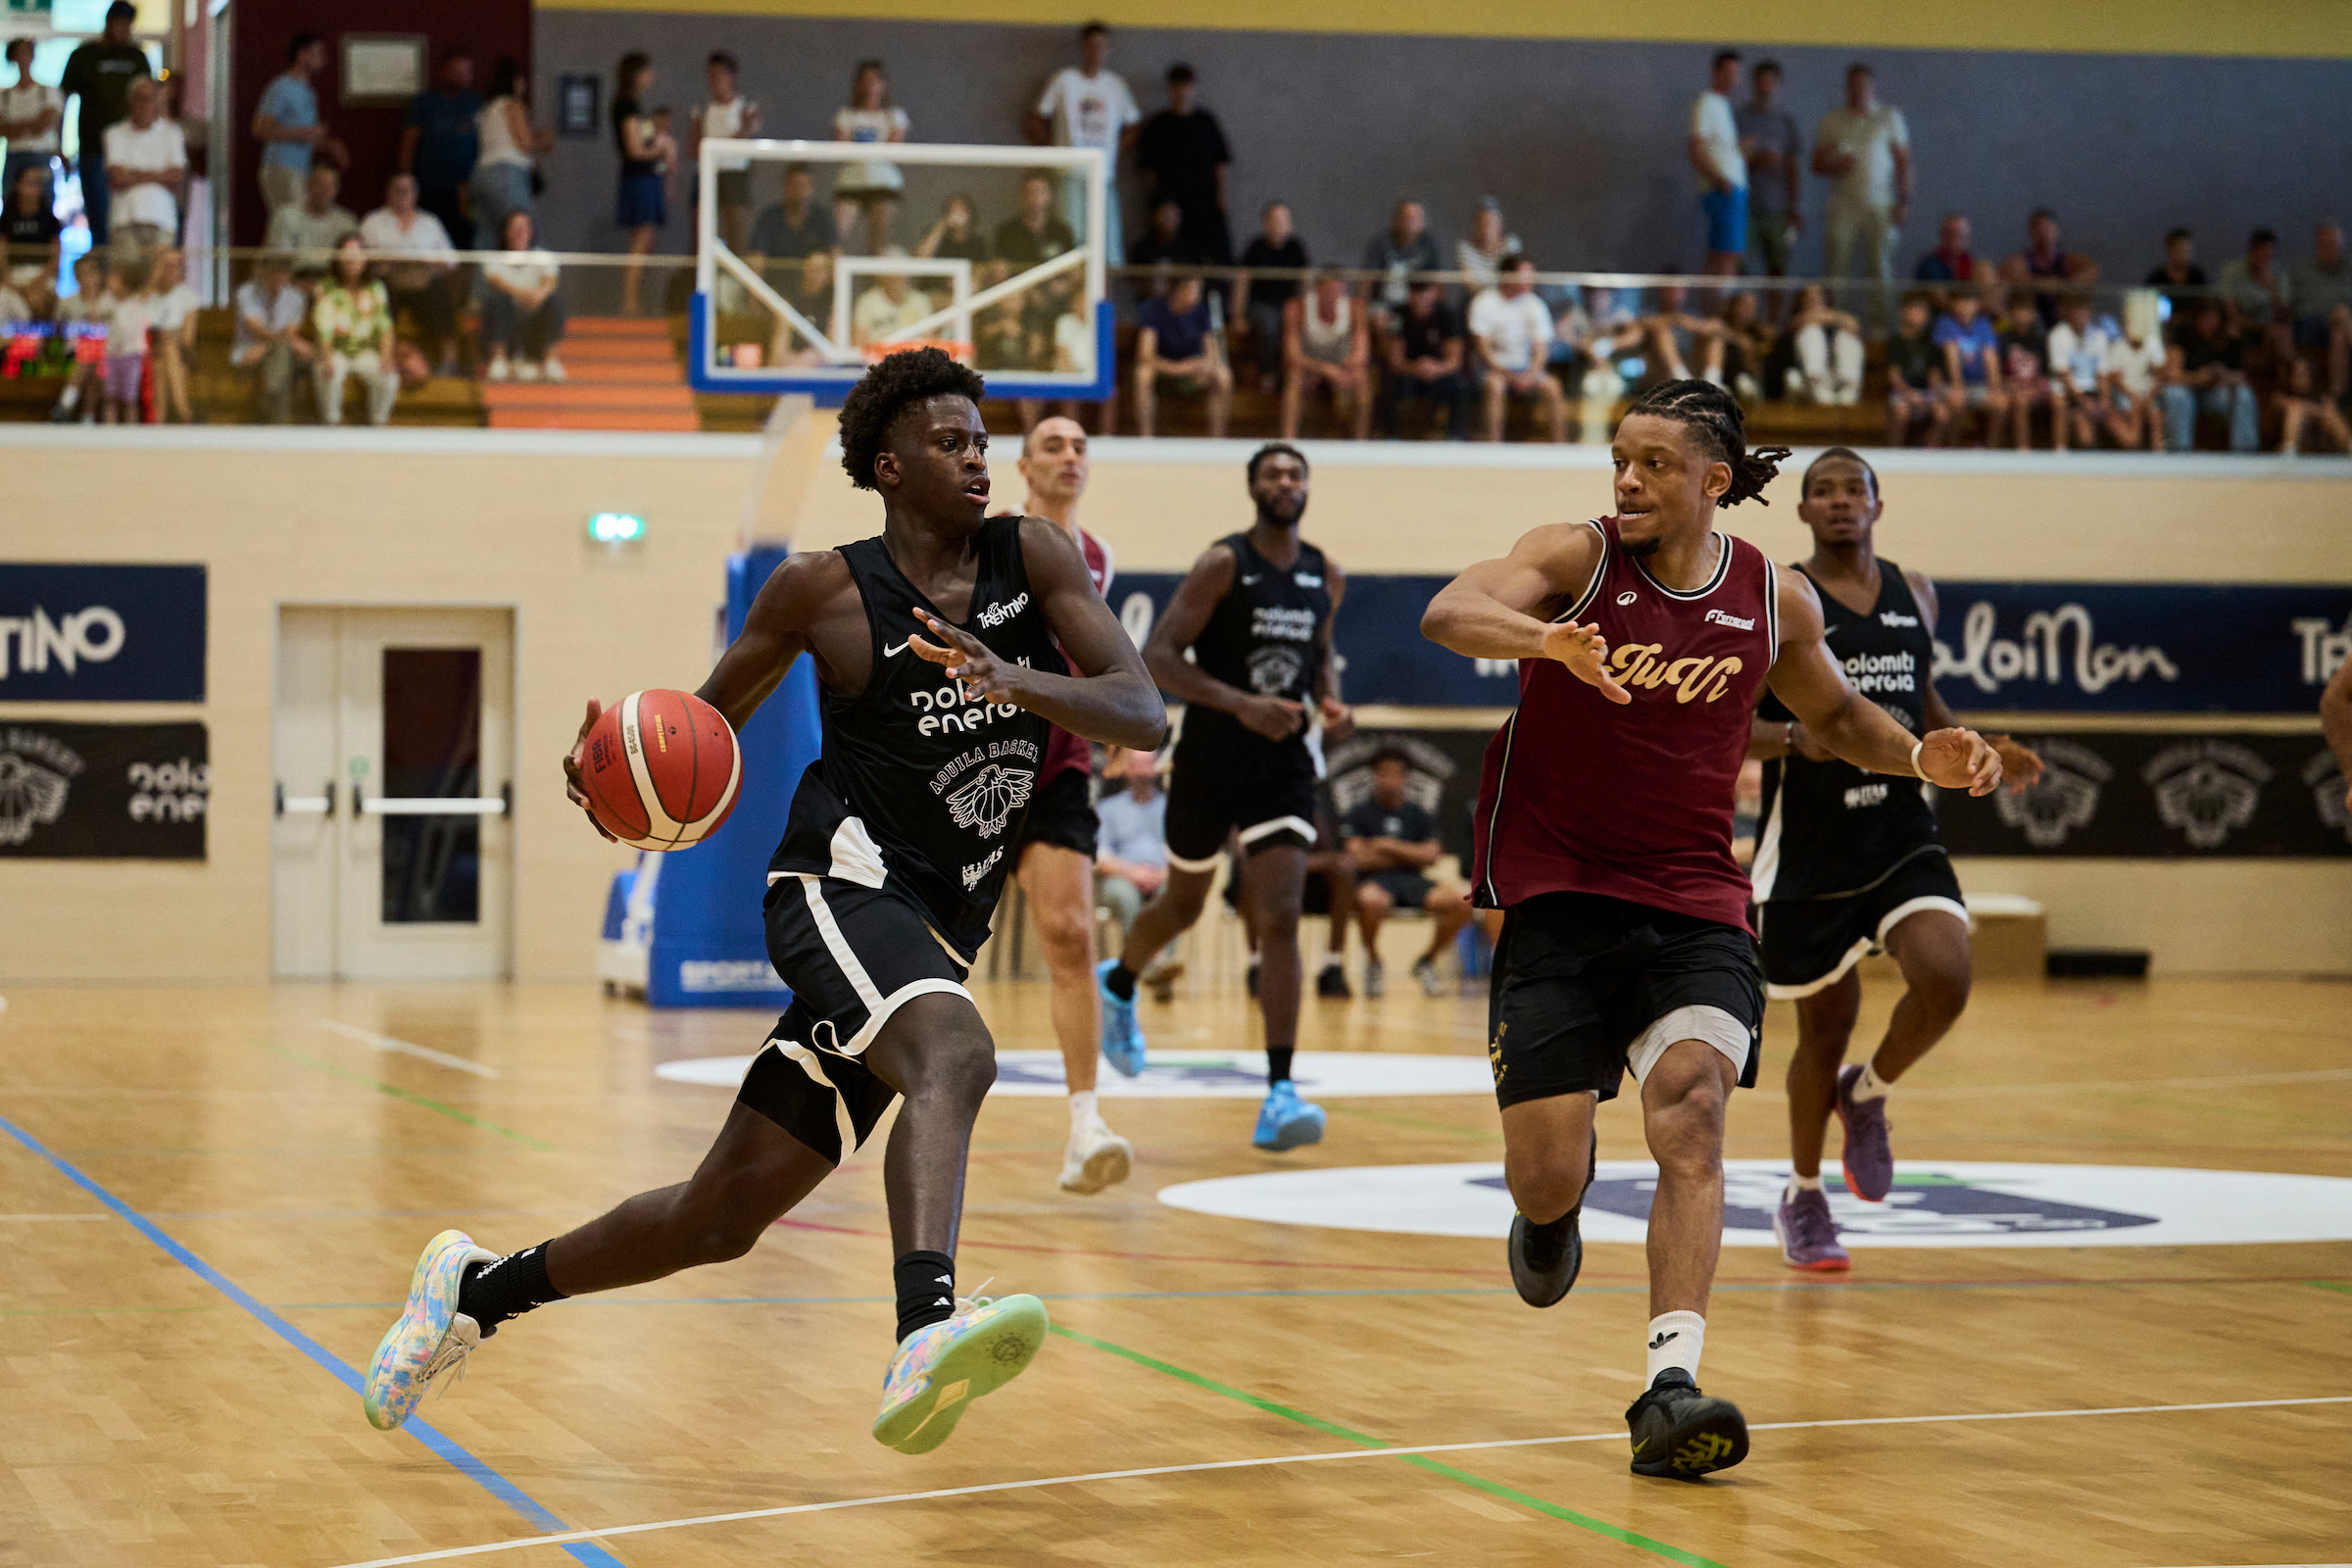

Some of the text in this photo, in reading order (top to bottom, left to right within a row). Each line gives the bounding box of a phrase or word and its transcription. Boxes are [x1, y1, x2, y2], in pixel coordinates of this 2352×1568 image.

[977, 592, 1029, 629] TRENTINO
[1848, 673, 1915, 693] nergia
[917, 703, 1026, 737] energ
[591, 738, 607, 774] FIBA
[929, 747, 986, 795] AQUILA
